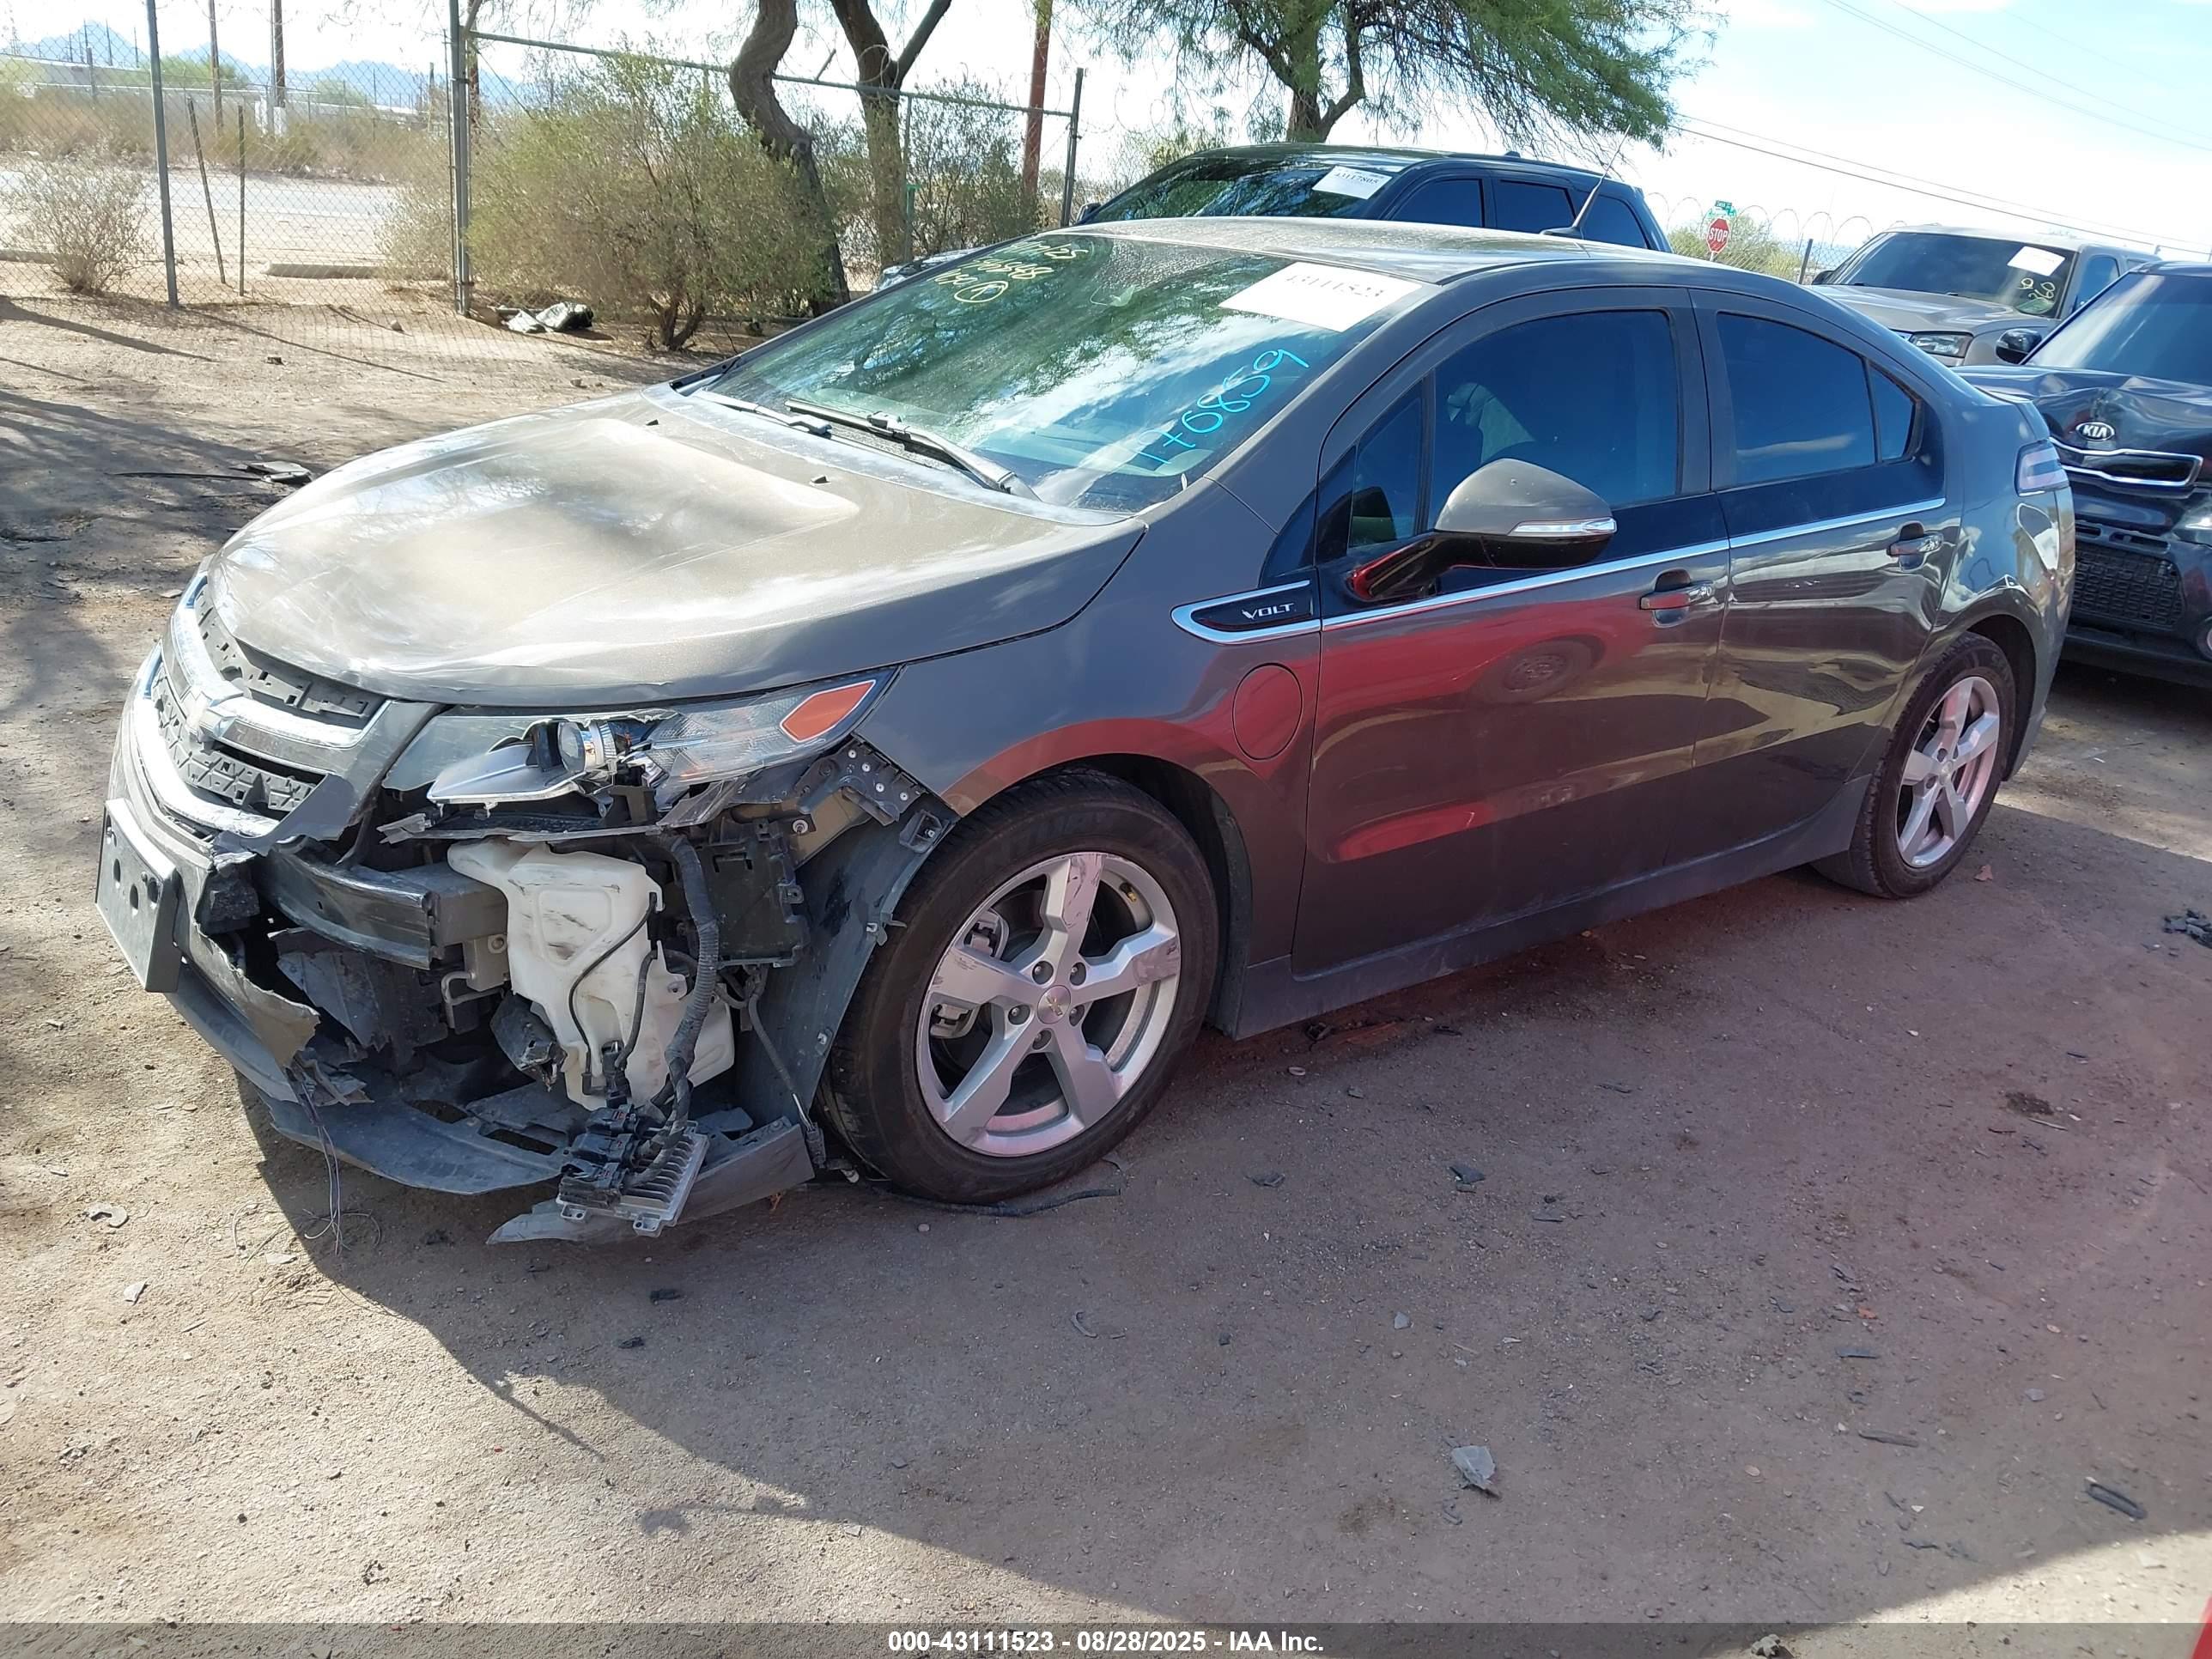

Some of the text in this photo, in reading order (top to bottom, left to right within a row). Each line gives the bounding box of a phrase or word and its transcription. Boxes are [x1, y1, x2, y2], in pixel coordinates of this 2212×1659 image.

[1709, 228, 1728, 242] STOP
[2082, 424, 2108, 438] KIA
[1242, 603, 1294, 619] VOLT
